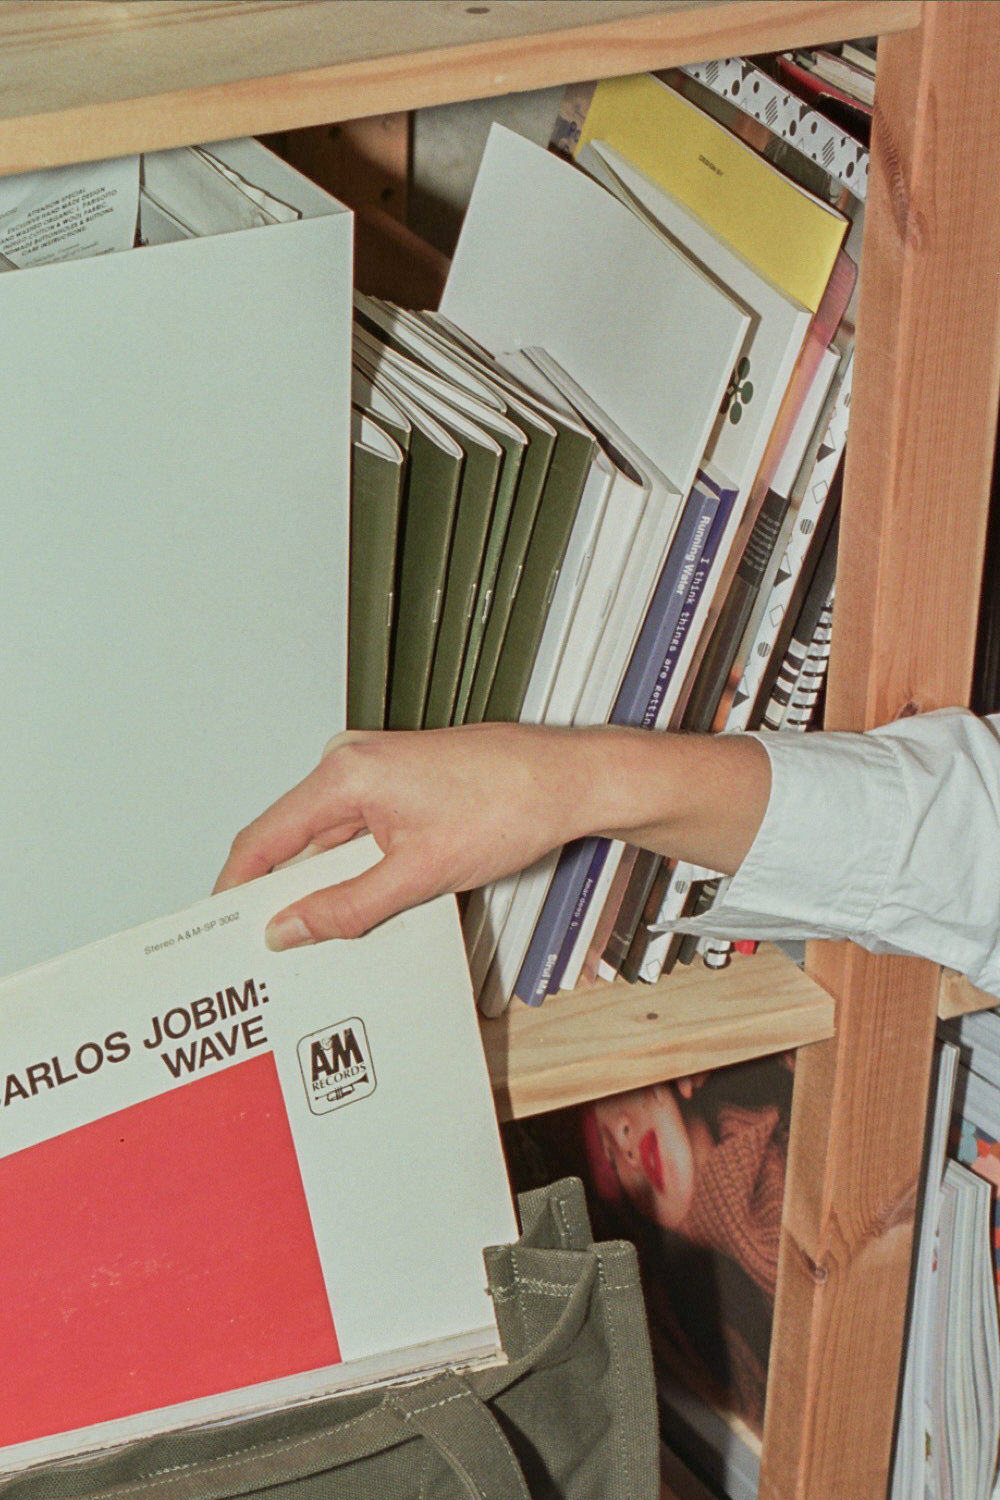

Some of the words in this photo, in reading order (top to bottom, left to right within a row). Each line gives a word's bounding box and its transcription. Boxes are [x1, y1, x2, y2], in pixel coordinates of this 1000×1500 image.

[683, 513, 711, 563] Running
[675, 561, 694, 596] Water
[685, 569, 704, 606] think
[667, 610, 690, 653] things
[658, 657, 673, 679] are
[143, 935, 176, 955] Stereo
[217, 910, 241, 927] 3002
[143, 979, 270, 1049] JOBIM:
[161, 1016, 268, 1079] WAVE
[311, 1062, 366, 1092] RECORDS
